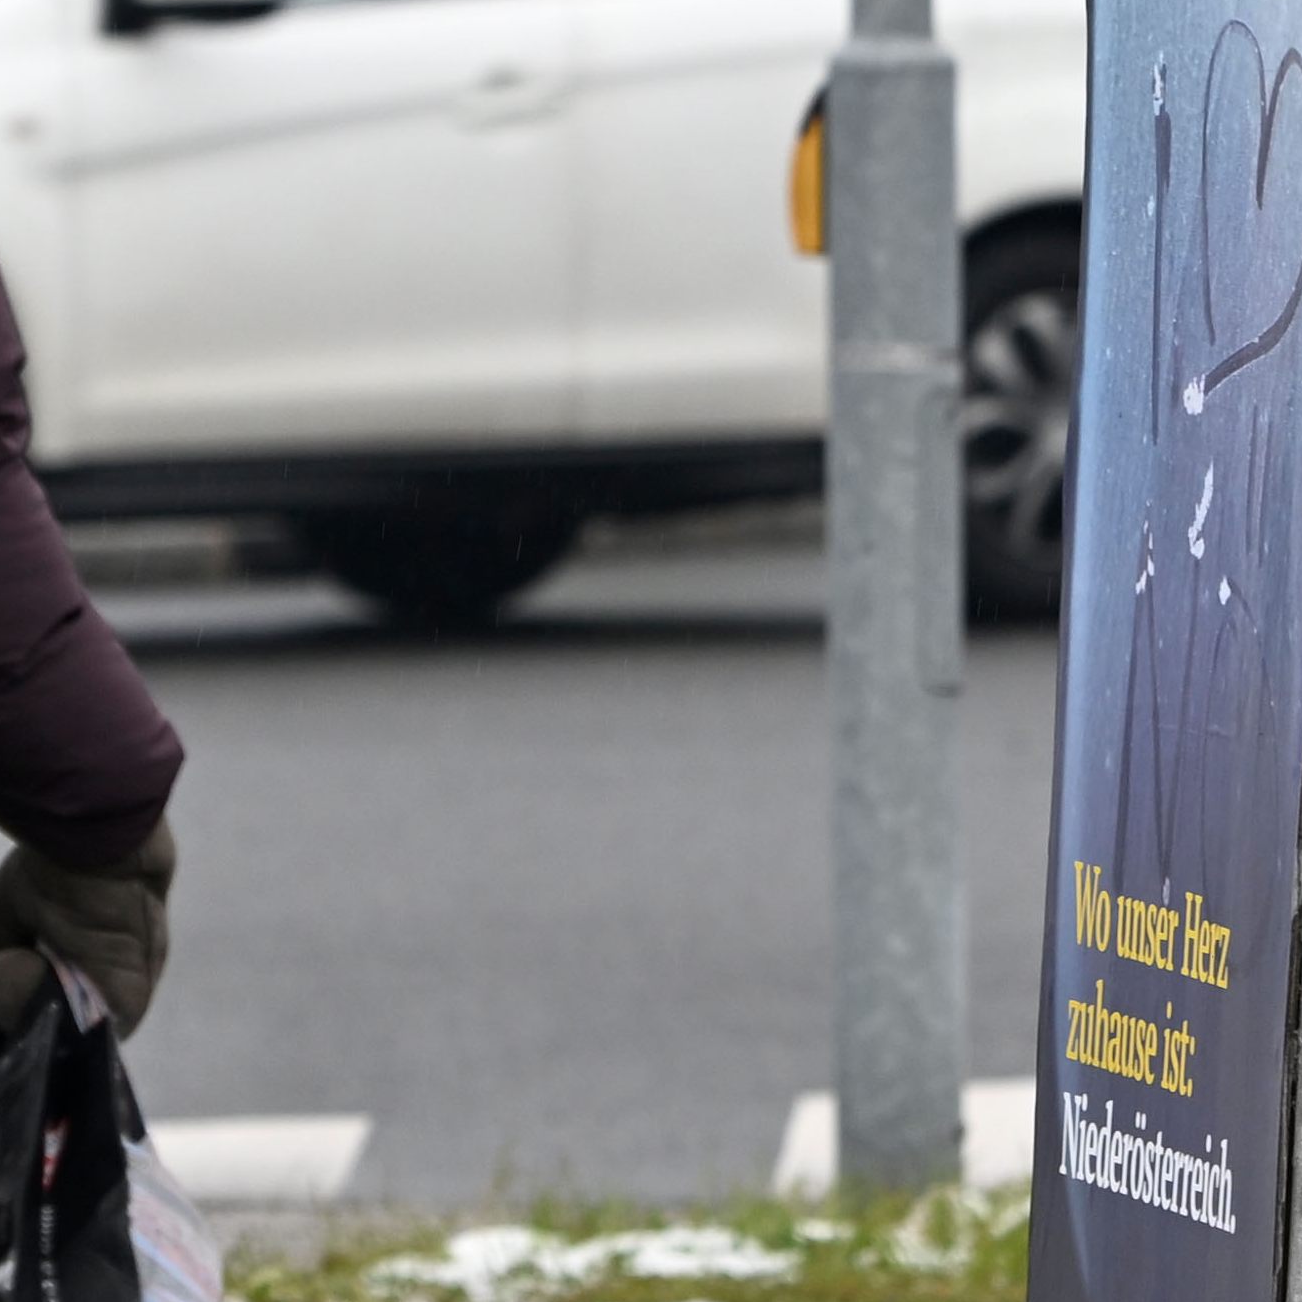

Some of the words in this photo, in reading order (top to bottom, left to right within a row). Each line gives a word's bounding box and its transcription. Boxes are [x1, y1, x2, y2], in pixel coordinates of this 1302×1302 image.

[1074, 861, 1111, 953] Wo
[1116, 894, 1179, 972] unser
[1180, 891, 1231, 990] Herz
[1065, 979, 1157, 1085] zuhause
[1160, 1001, 1196, 1098] ist:
[1059, 1091, 1237, 1235] Niederösterreich.
